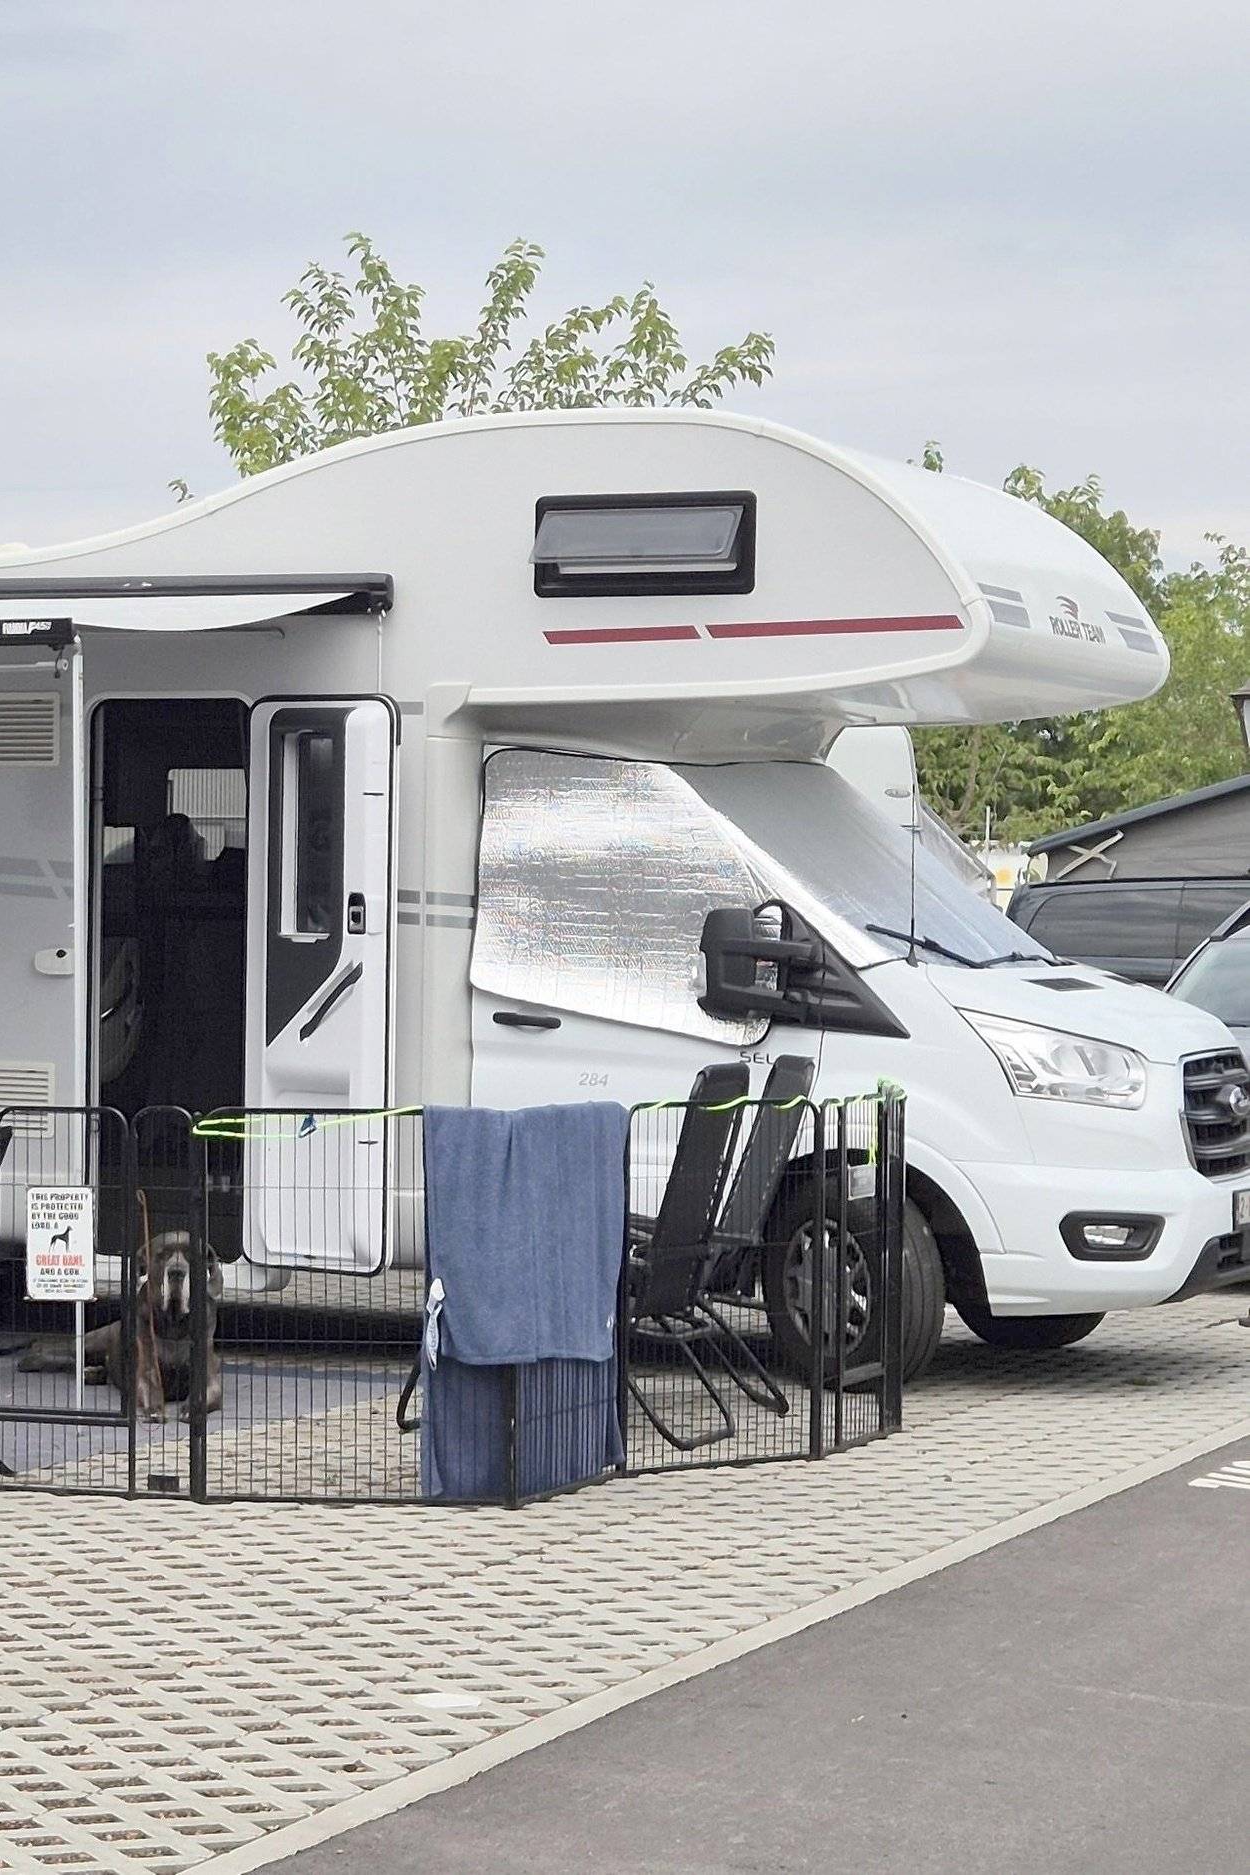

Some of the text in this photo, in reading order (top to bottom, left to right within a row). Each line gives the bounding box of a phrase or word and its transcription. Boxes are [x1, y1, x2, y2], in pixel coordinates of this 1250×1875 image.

[1049, 616, 1107, 645] ROLLER TEAM
[740, 1051, 774, 1065] SEL
[578, 1073, 609, 1087] 284
